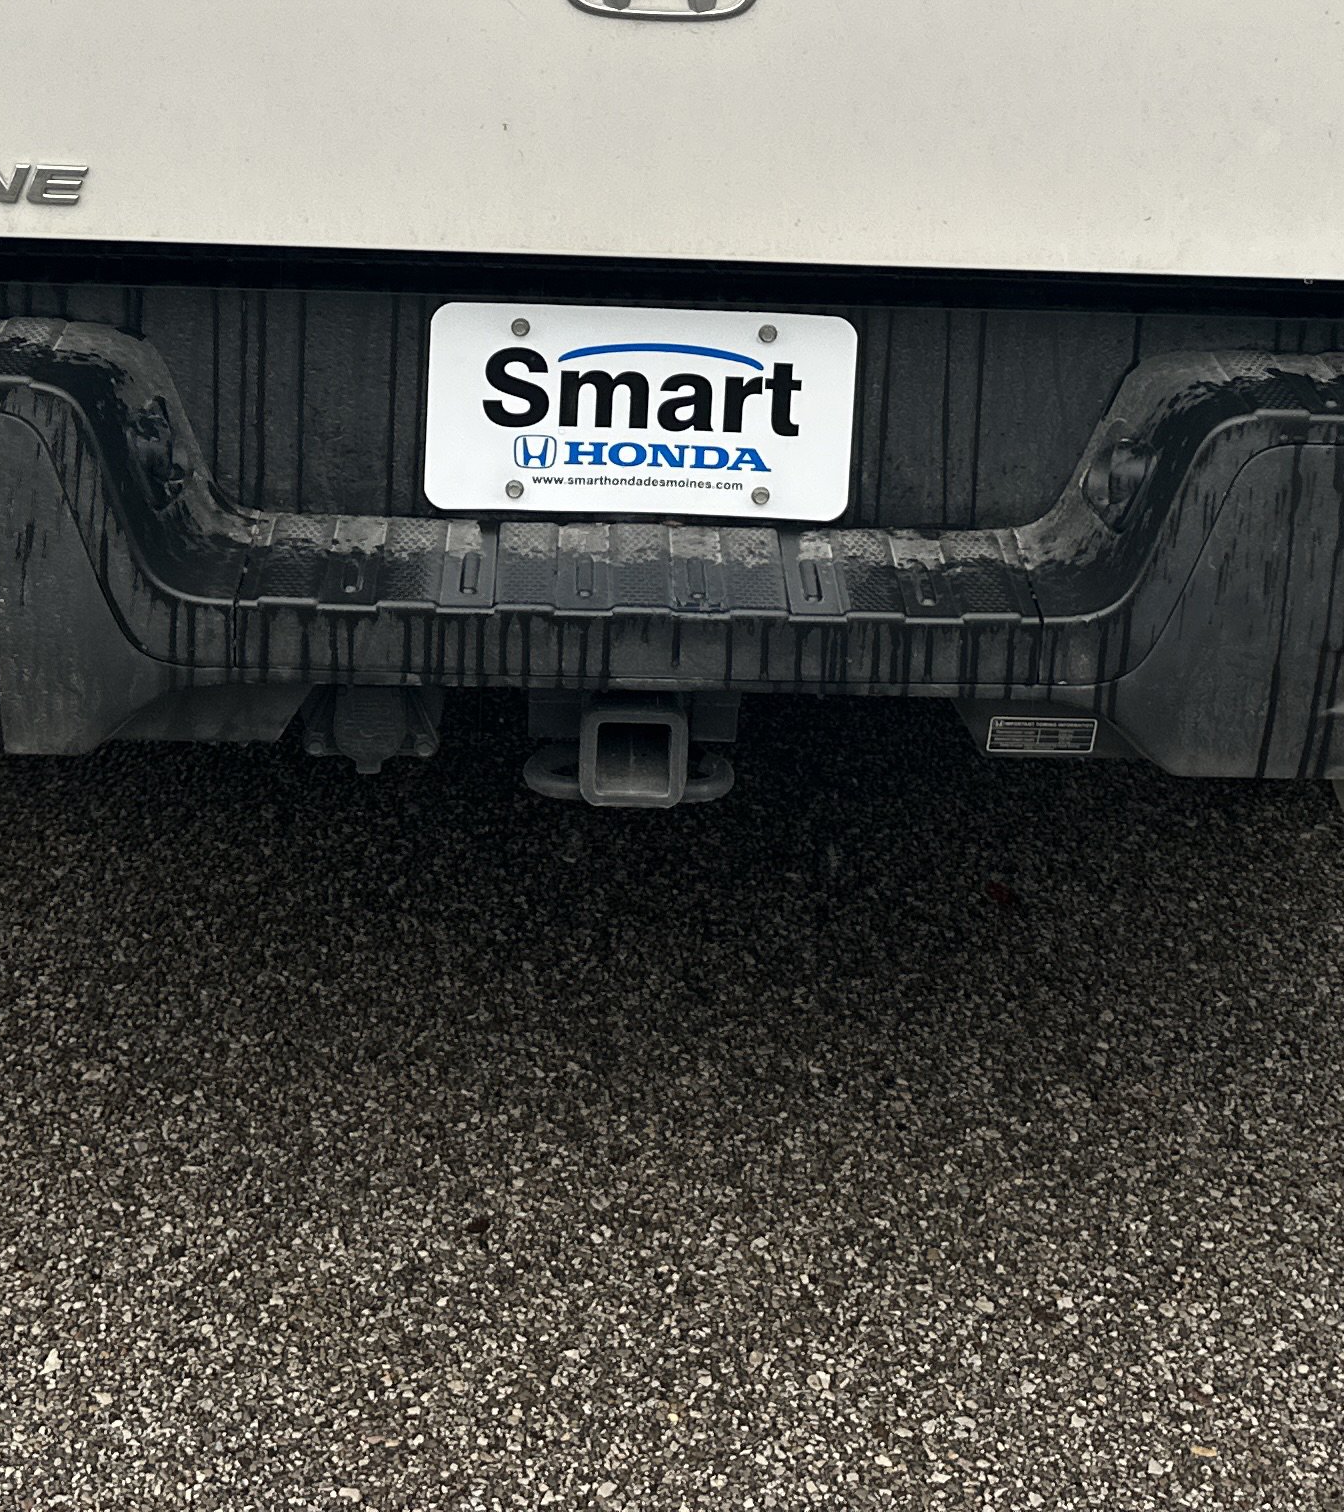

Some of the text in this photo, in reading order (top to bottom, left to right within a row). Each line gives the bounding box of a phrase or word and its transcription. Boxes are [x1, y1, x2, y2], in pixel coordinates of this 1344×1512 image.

[482, 347, 803, 437] Smart
[564, 441, 771, 473] HONDA
[531, 474, 744, 492] www.smarthondadesmoines.com
